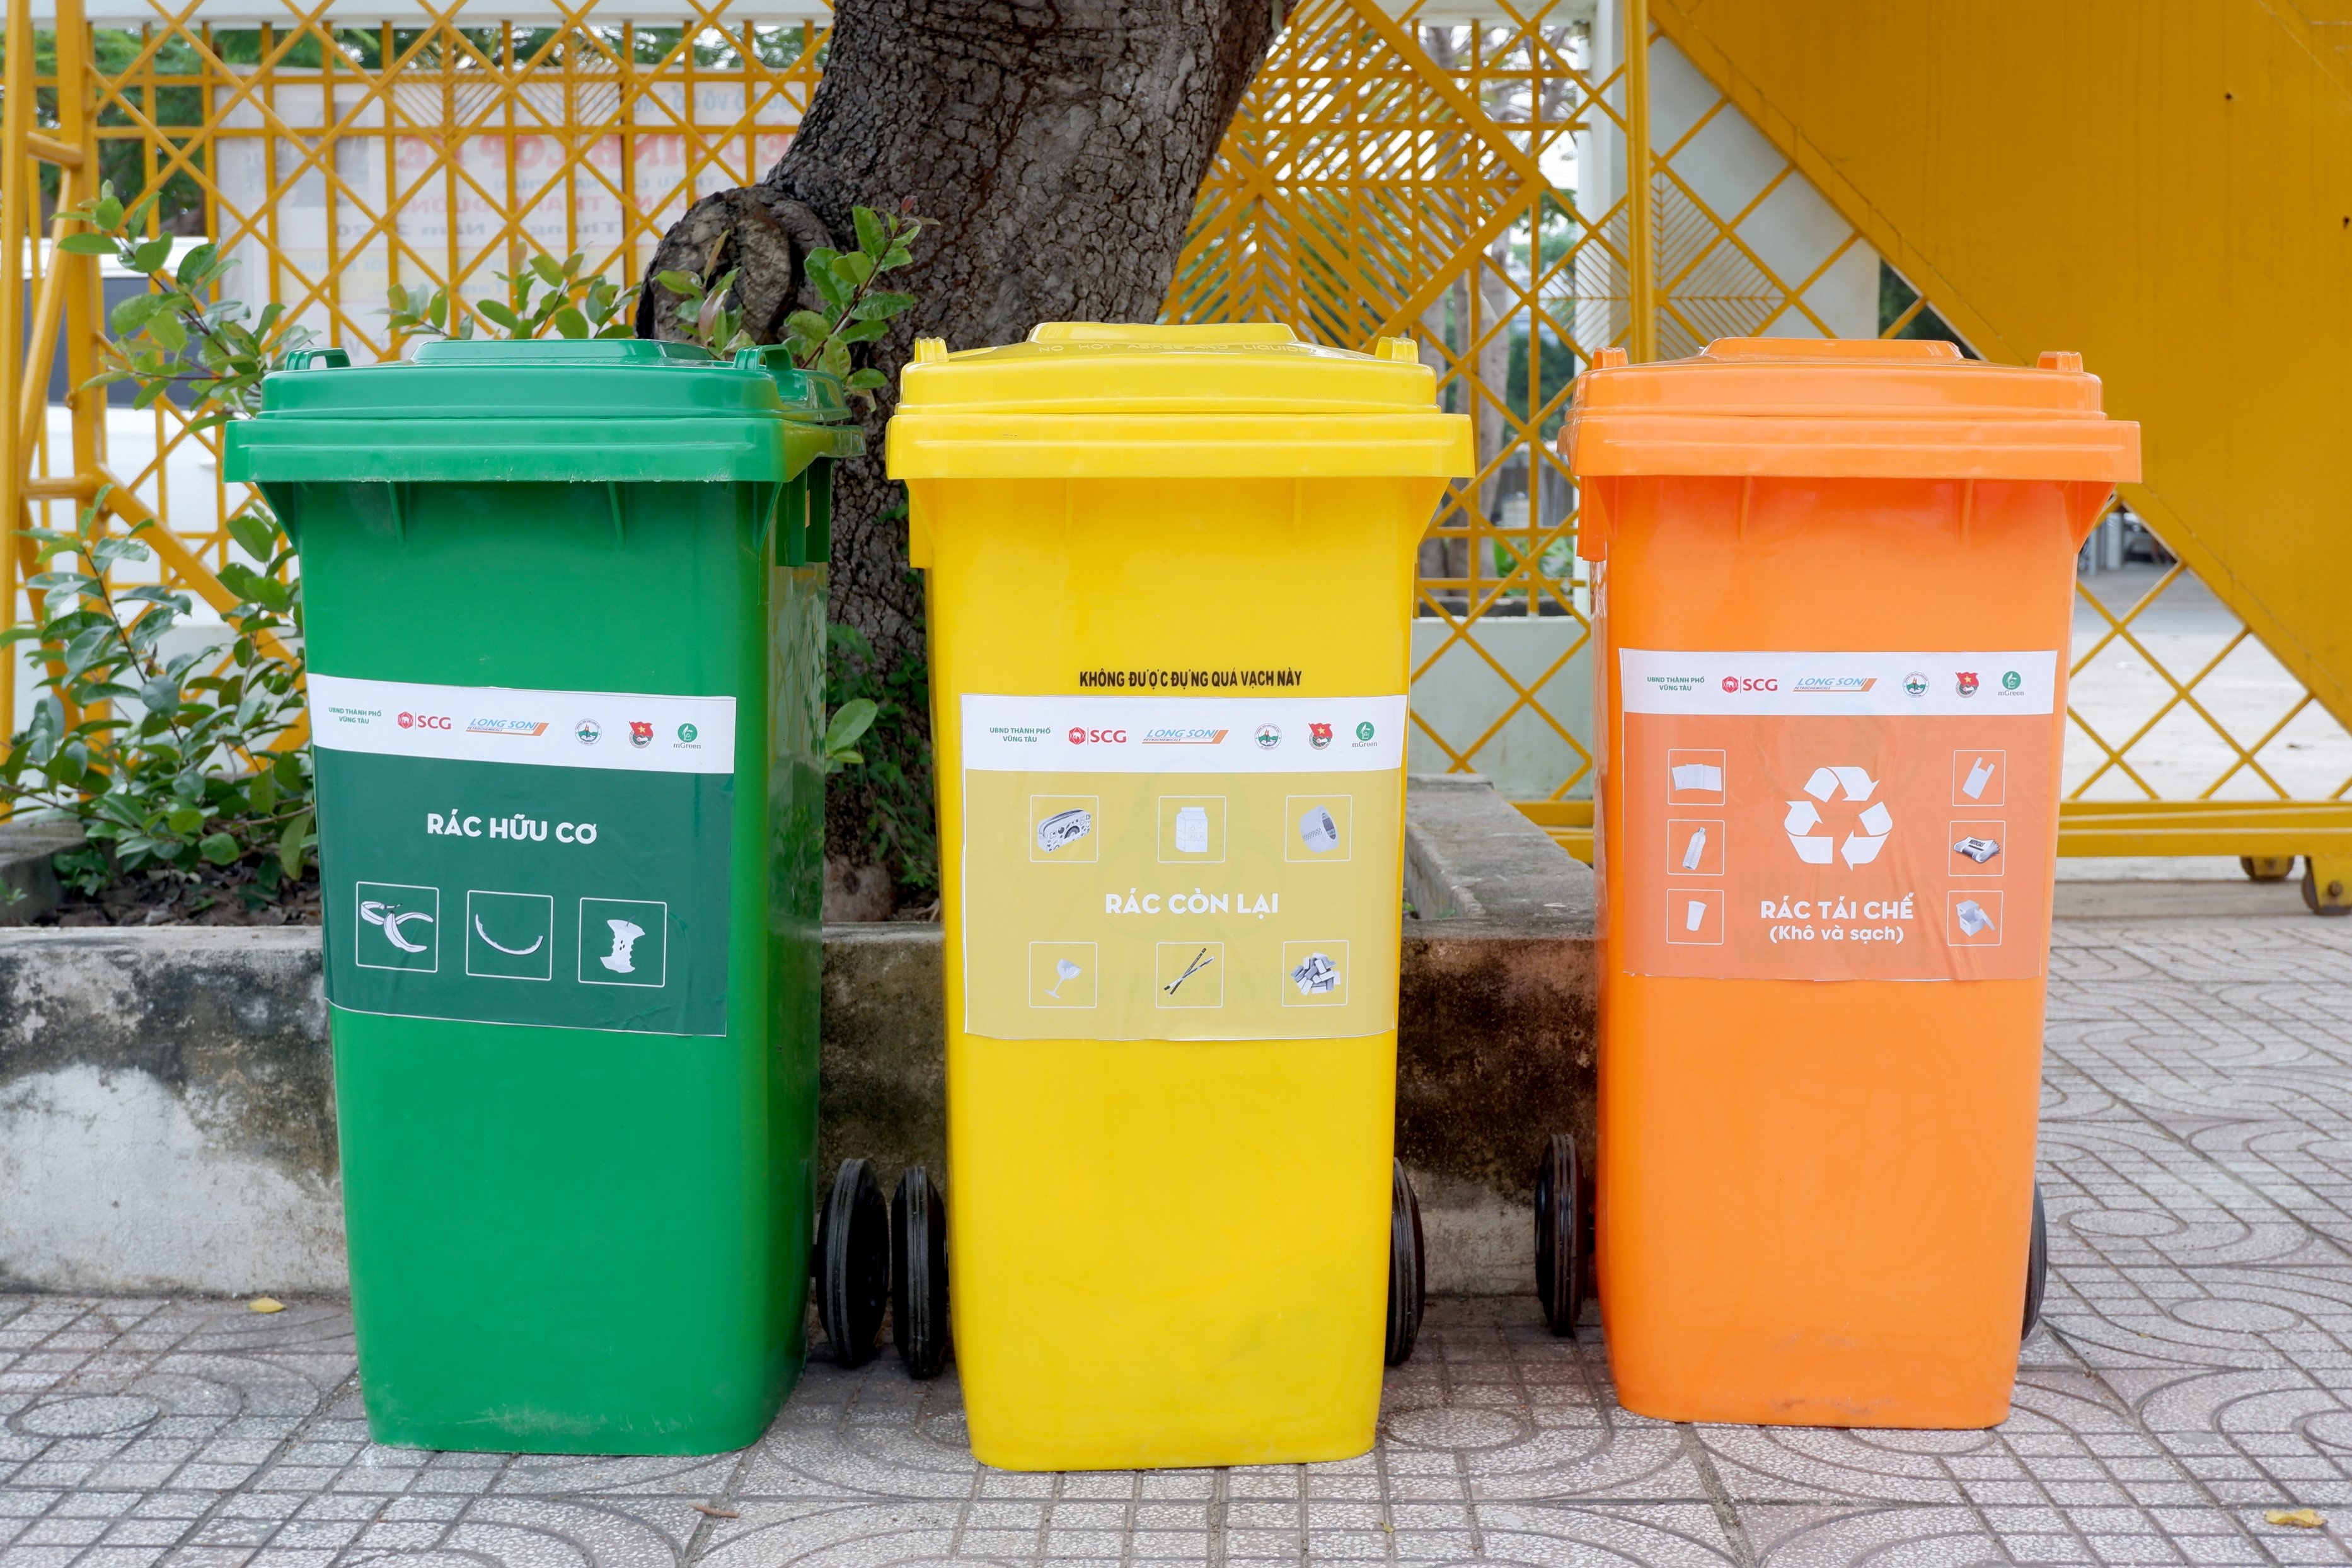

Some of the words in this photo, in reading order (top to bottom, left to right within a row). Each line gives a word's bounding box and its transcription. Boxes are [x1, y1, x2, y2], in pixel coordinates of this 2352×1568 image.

[1080, 668, 1125, 687] KHÔNG
[1211, 667, 1238, 687] QUÁ
[1240, 670, 1274, 689] VẠCH
[1277, 667, 1302, 686] NÀY
[1690, 676, 1705, 684] PHỐ
[1797, 677, 1836, 686] LONG
[1836, 677, 1864, 686] SON
[1743, 679, 1778, 691] SCG
[345, 707, 367, 716] THÀNH
[417, 715, 451, 730] SCG
[470, 718, 507, 727] LONG
[508, 720, 536, 729] SON
[1090, 730, 1127, 743] SCG
[1146, 729, 1186, 737] LONG
[1186, 729, 1216, 737] SON
[427, 809, 482, 837] RÁC
[490, 814, 548, 841] HỮU
[555, 822, 597, 845] CƠ
[1105, 887, 1161, 914] RÁC
[1168, 887, 1228, 914] CÒN
[1237, 893, 1279, 919] LẠI
[1761, 895, 1811, 919] RÁC
[1818, 896, 1857, 919] TÁI
[1863, 891, 1915, 919] CHẾ
[1769, 925, 1815, 944] (Khô
[1821, 924, 1844, 941] và
[1850, 926, 1905, 945] sạch)
